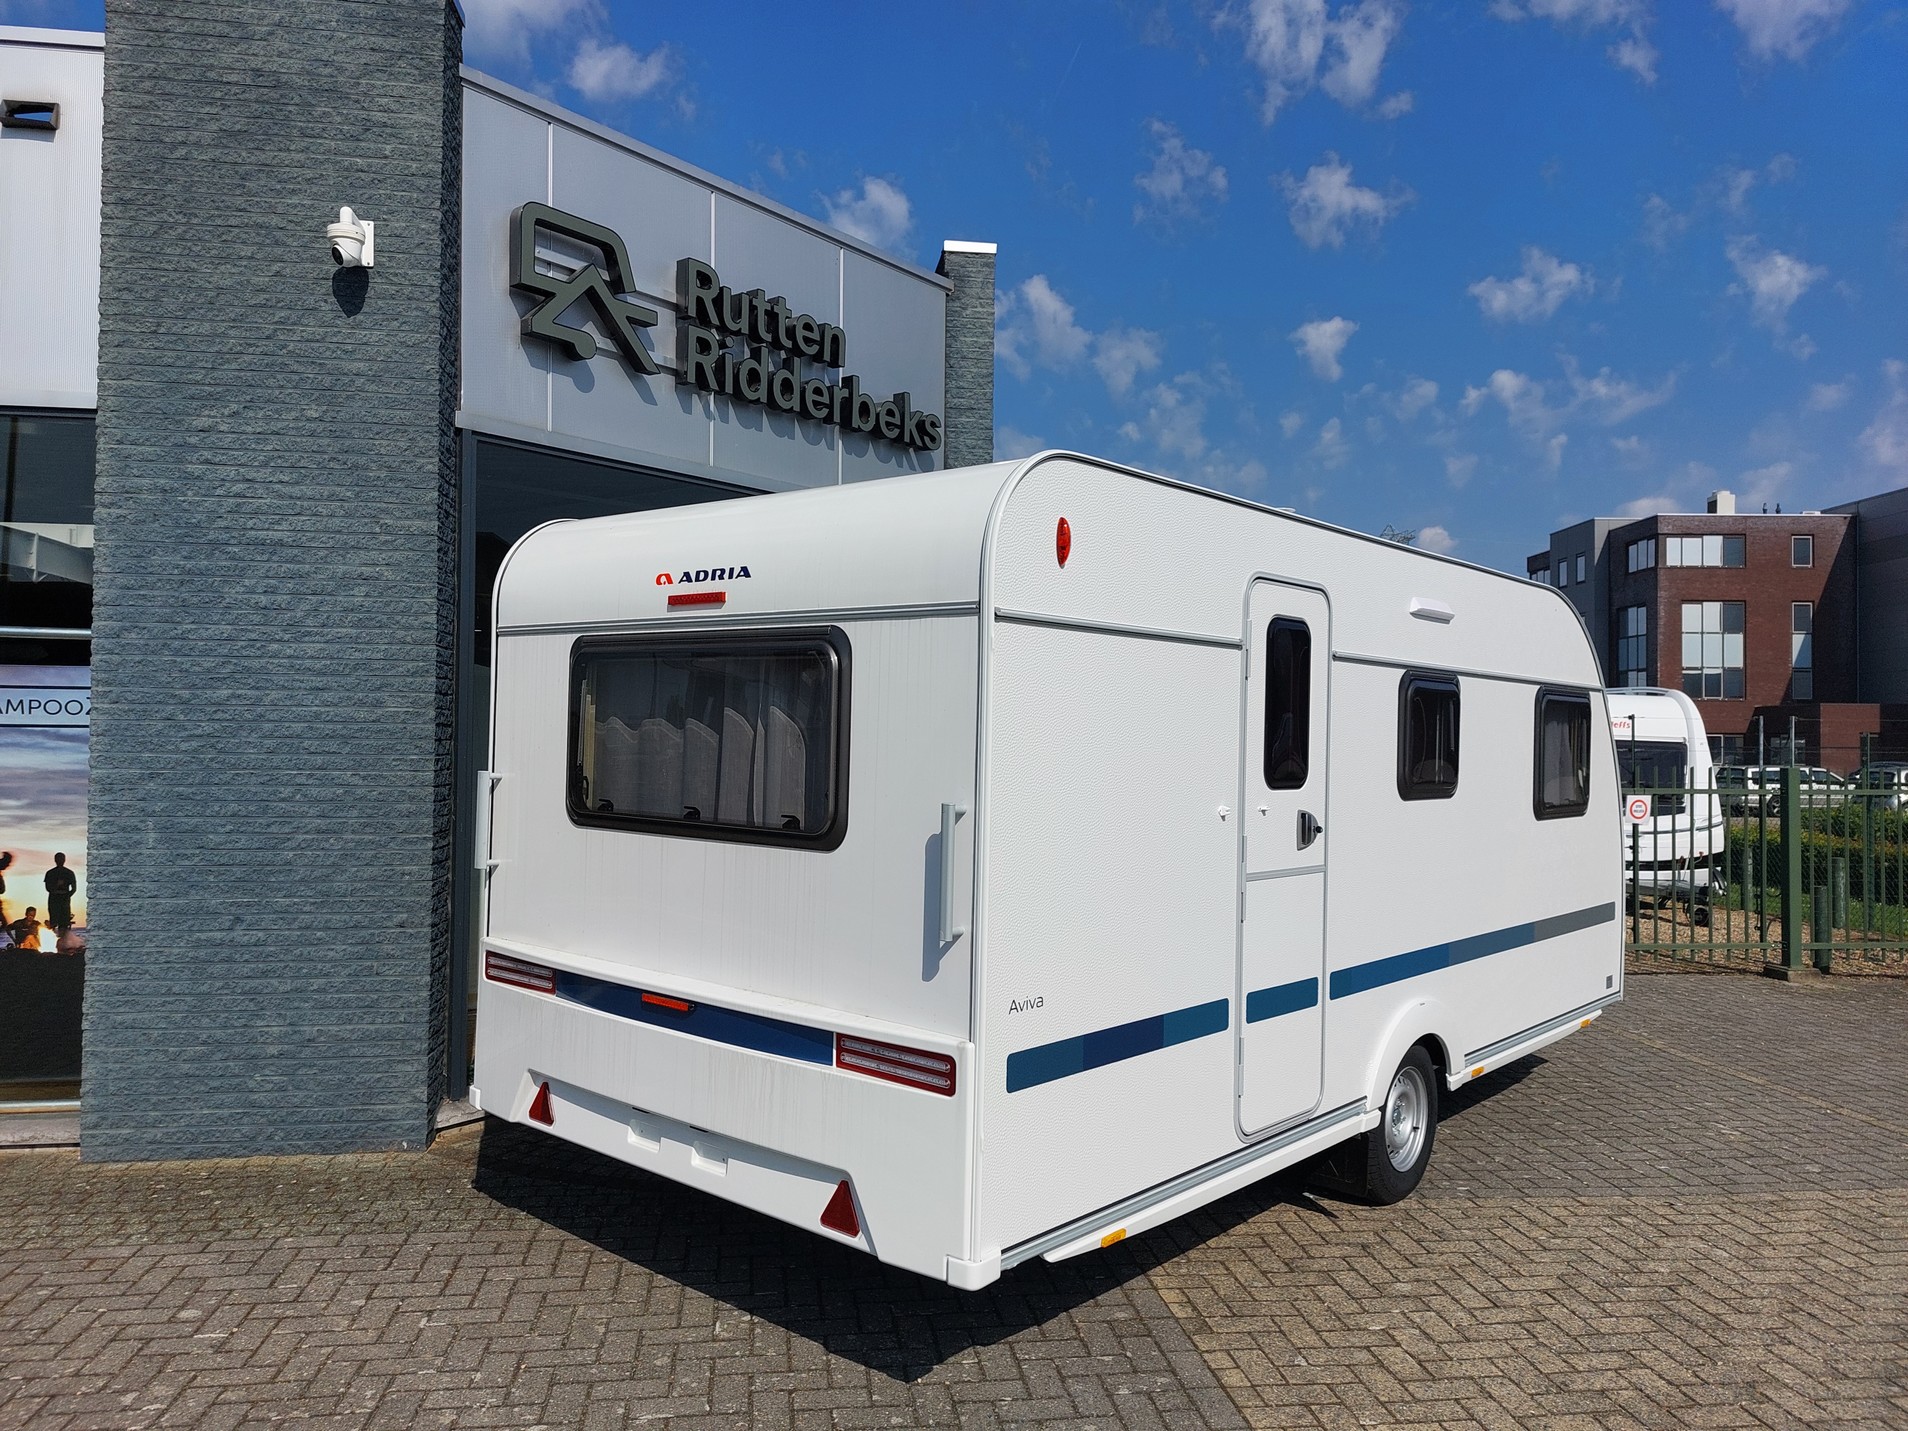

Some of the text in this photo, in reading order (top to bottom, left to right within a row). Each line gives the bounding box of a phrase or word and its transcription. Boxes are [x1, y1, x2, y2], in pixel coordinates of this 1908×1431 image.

[677, 257, 846, 368] Rutten
[676, 325, 943, 451] Ridderbeks
[678, 566, 752, 584] ADRIA
[0, 697, 91, 716] MPOO
[1009, 995, 1044, 1015] Aviva
